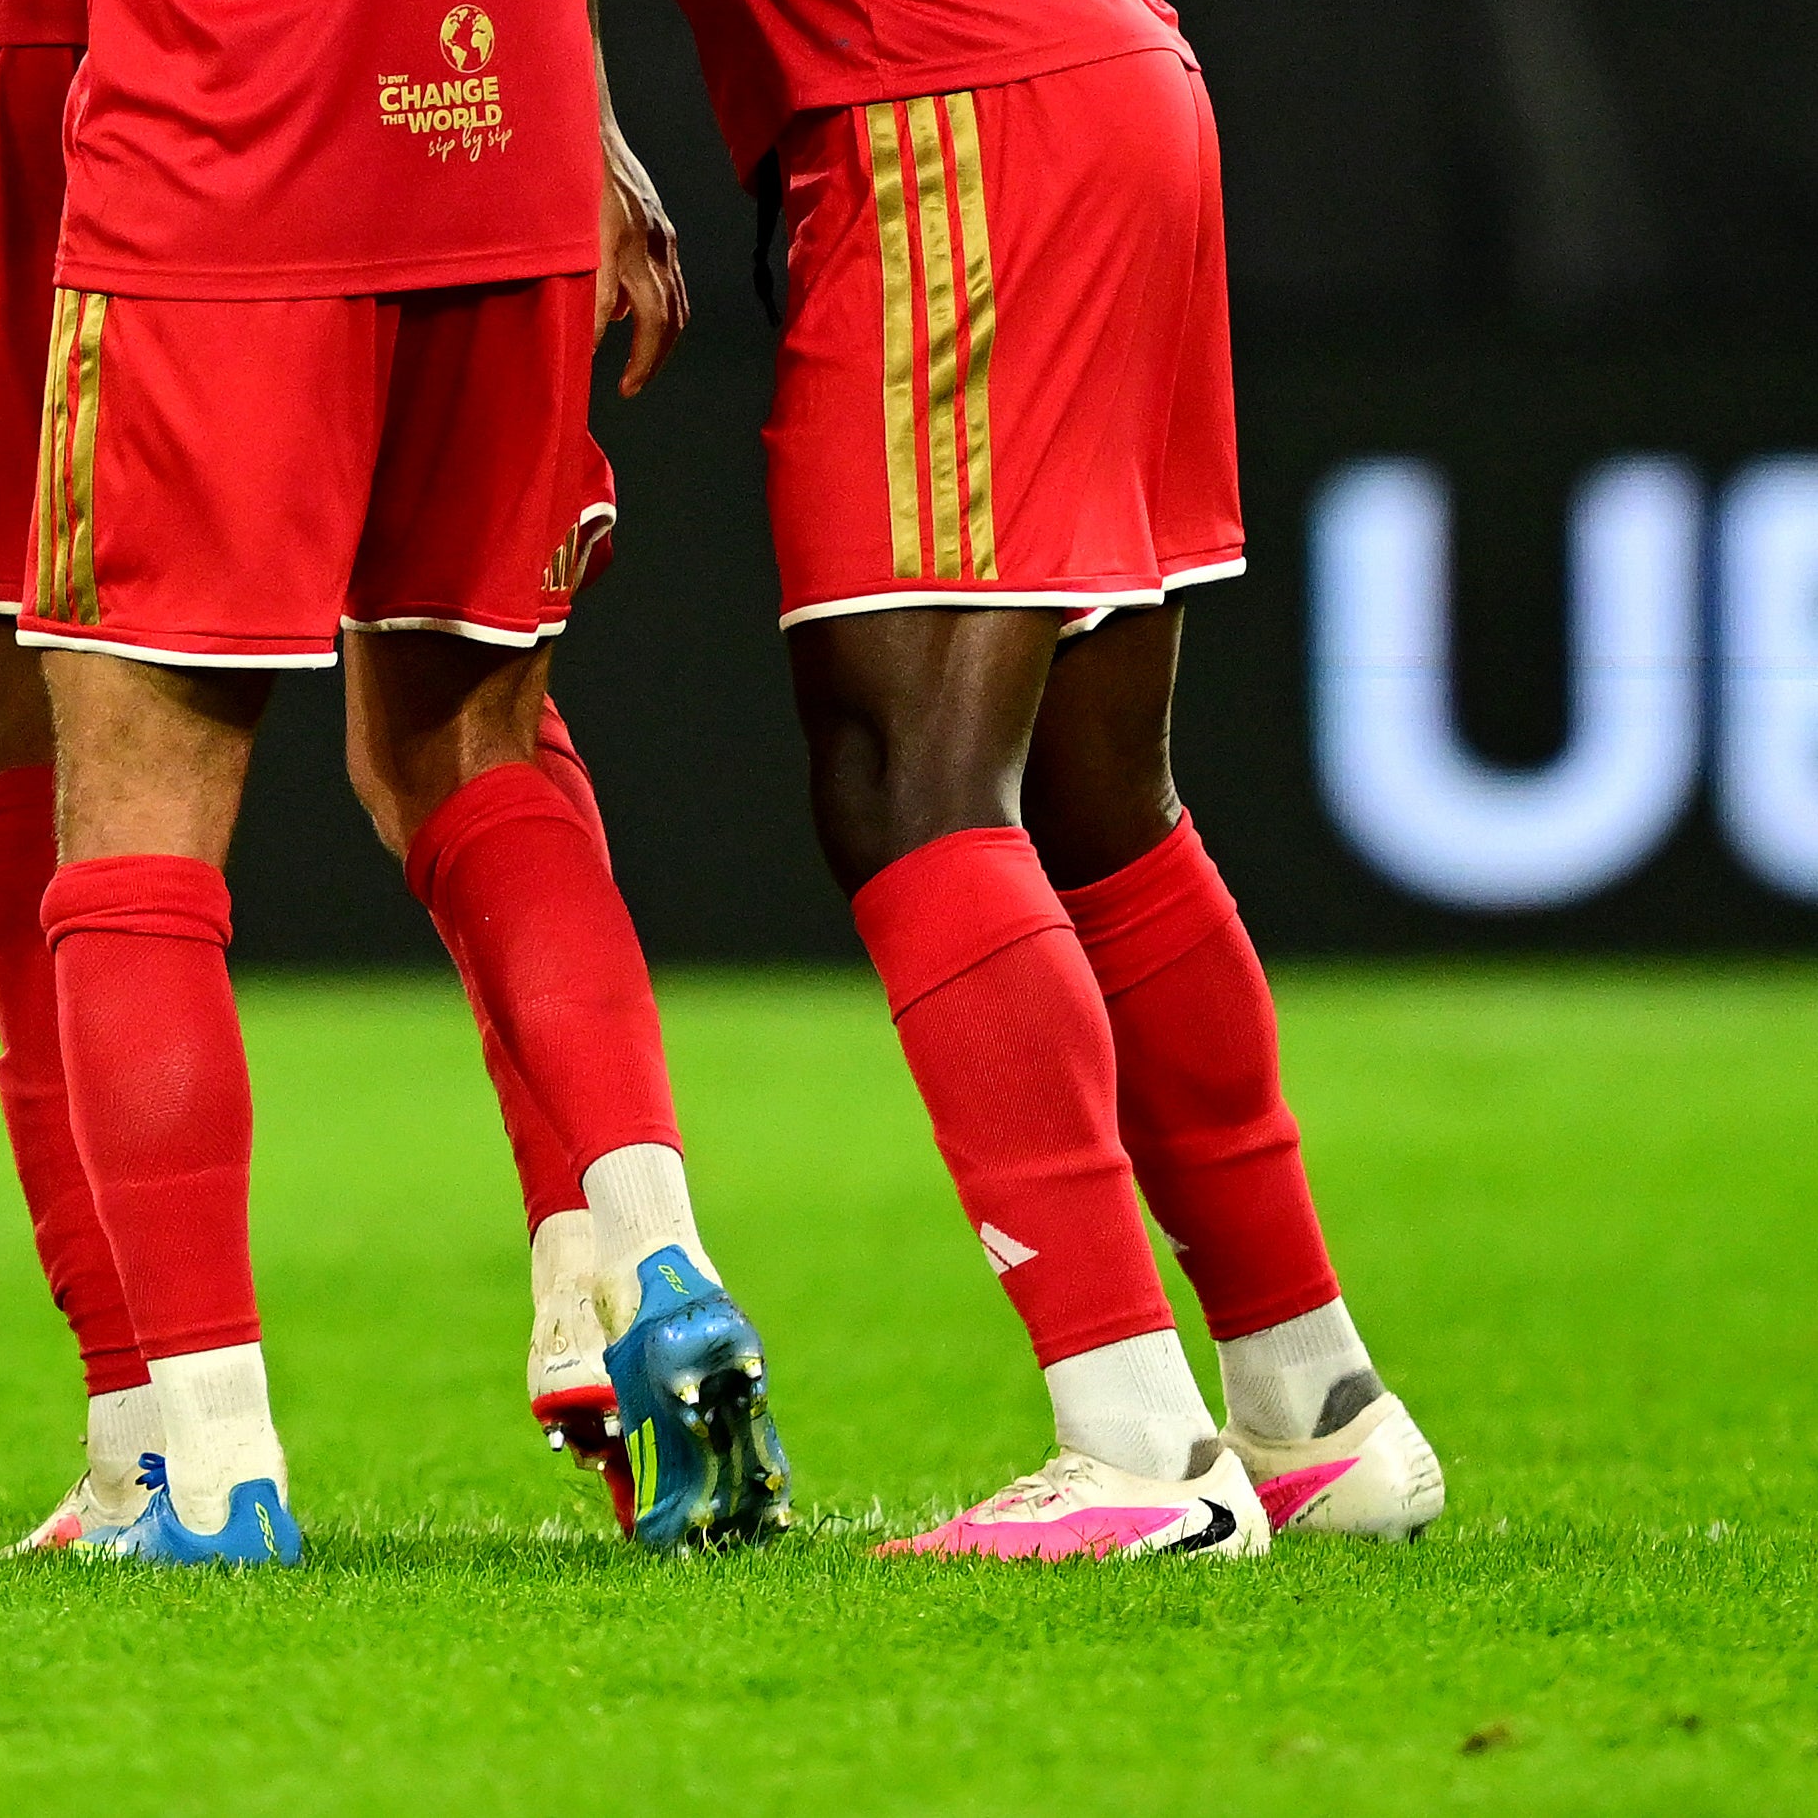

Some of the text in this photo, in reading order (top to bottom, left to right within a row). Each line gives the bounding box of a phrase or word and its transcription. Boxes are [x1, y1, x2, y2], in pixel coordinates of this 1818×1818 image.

[379, 76, 500, 112] CHANGE
[380, 104, 503, 134] THE WORLD
[428, 120, 512, 163] sip by sip
